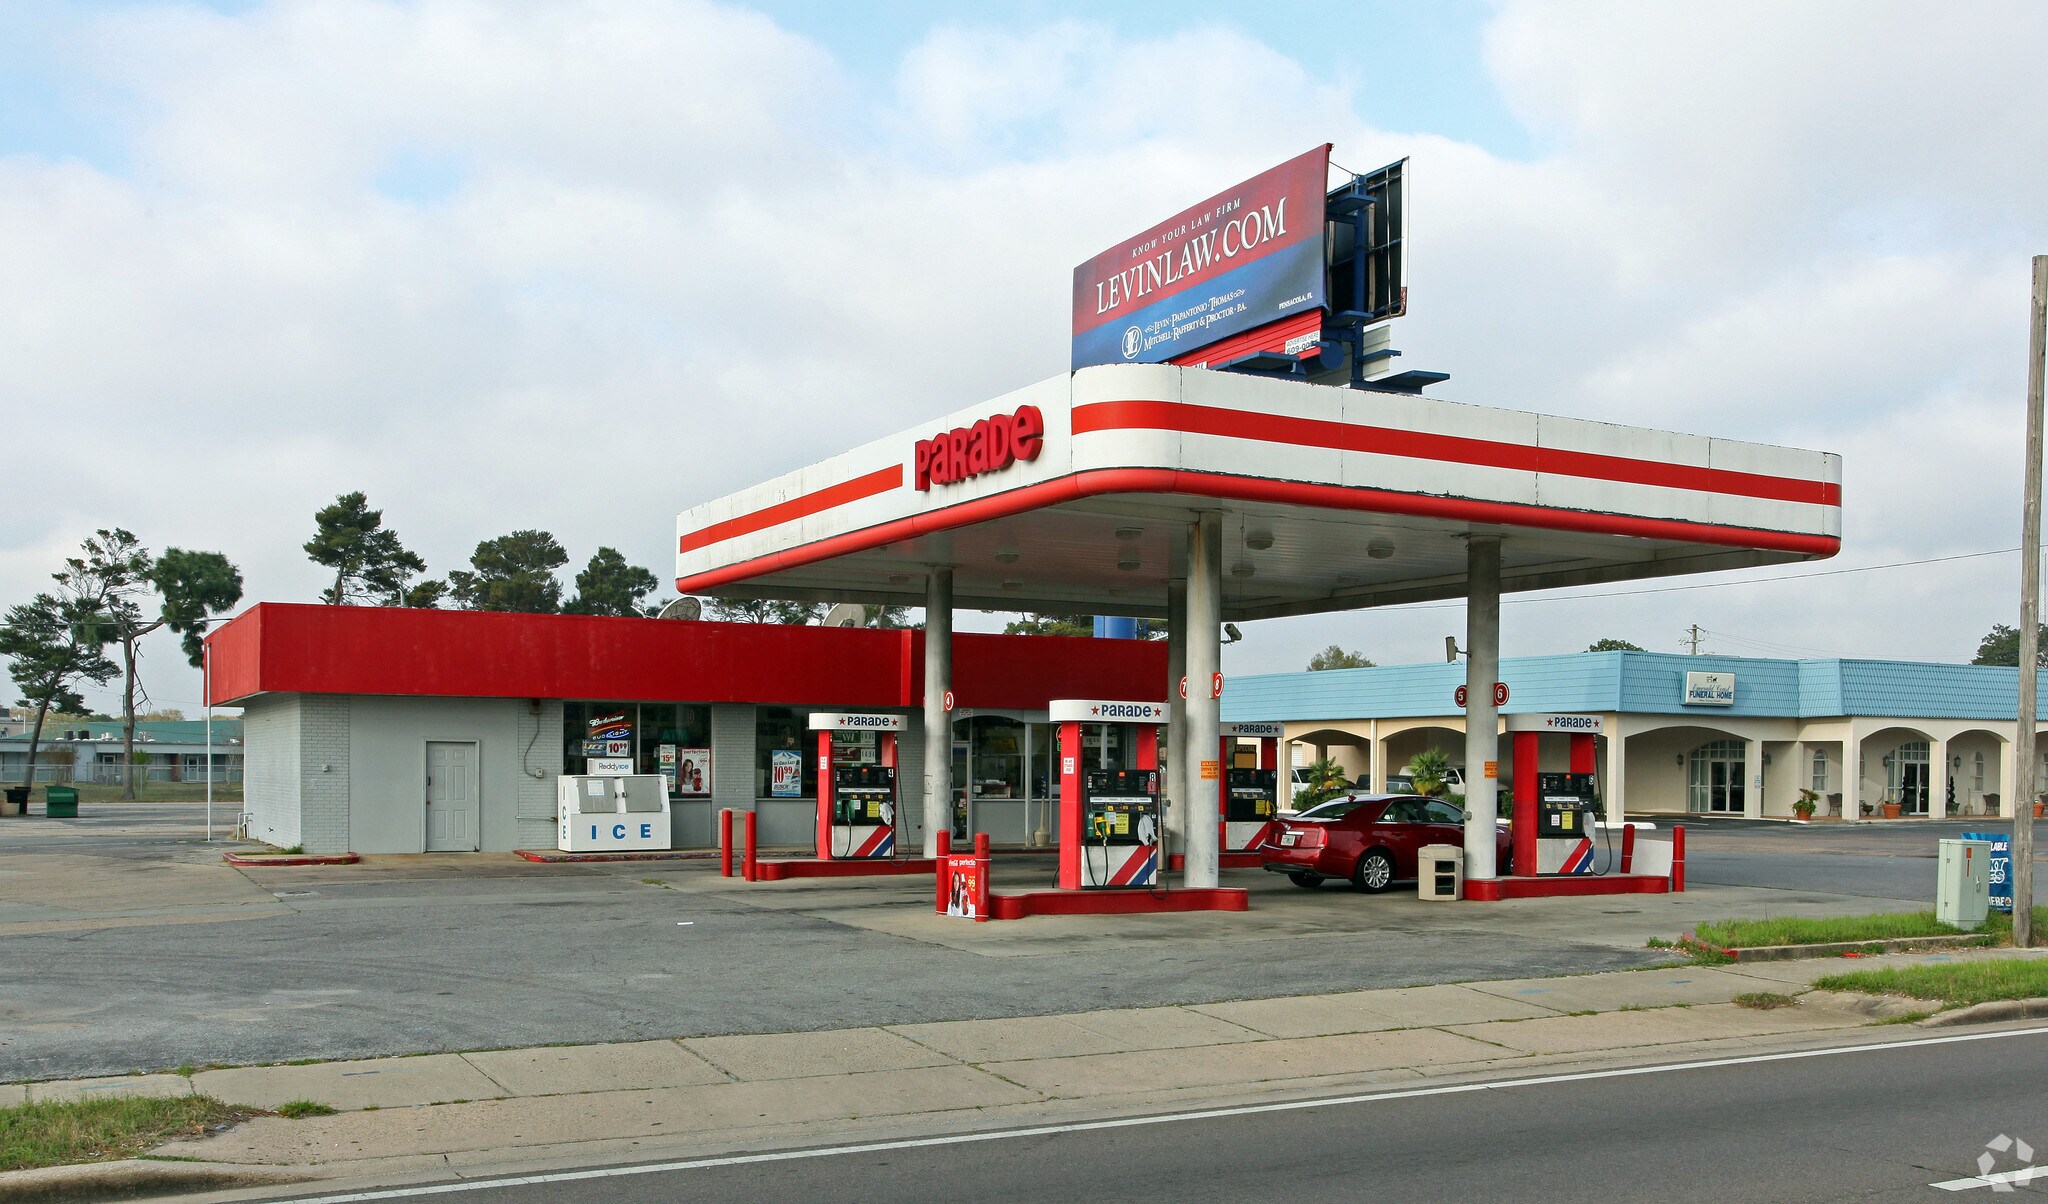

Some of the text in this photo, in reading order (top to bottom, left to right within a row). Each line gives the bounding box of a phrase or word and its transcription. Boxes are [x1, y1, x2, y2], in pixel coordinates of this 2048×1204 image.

[1132, 198, 1241, 258] KNOW YOUR LAW FIRM
[1096, 197, 1287, 315] LEVINLAW.COM
[1154, 291, 1234, 334] LEVIN PAPANTONIO THOMAS
[1144, 332, 1171, 351] MITCHELL
[1173, 320, 1200, 341] RAFFERTY
[1206, 307, 1234, 329] PROCTOR
[1215, 679, 1220, 690] 8
[1457, 691, 1464, 701] 5
[1497, 688, 1503, 699] 6
[589, 715, 625, 727] Budweiser
[591, 824, 651, 839] ICE
